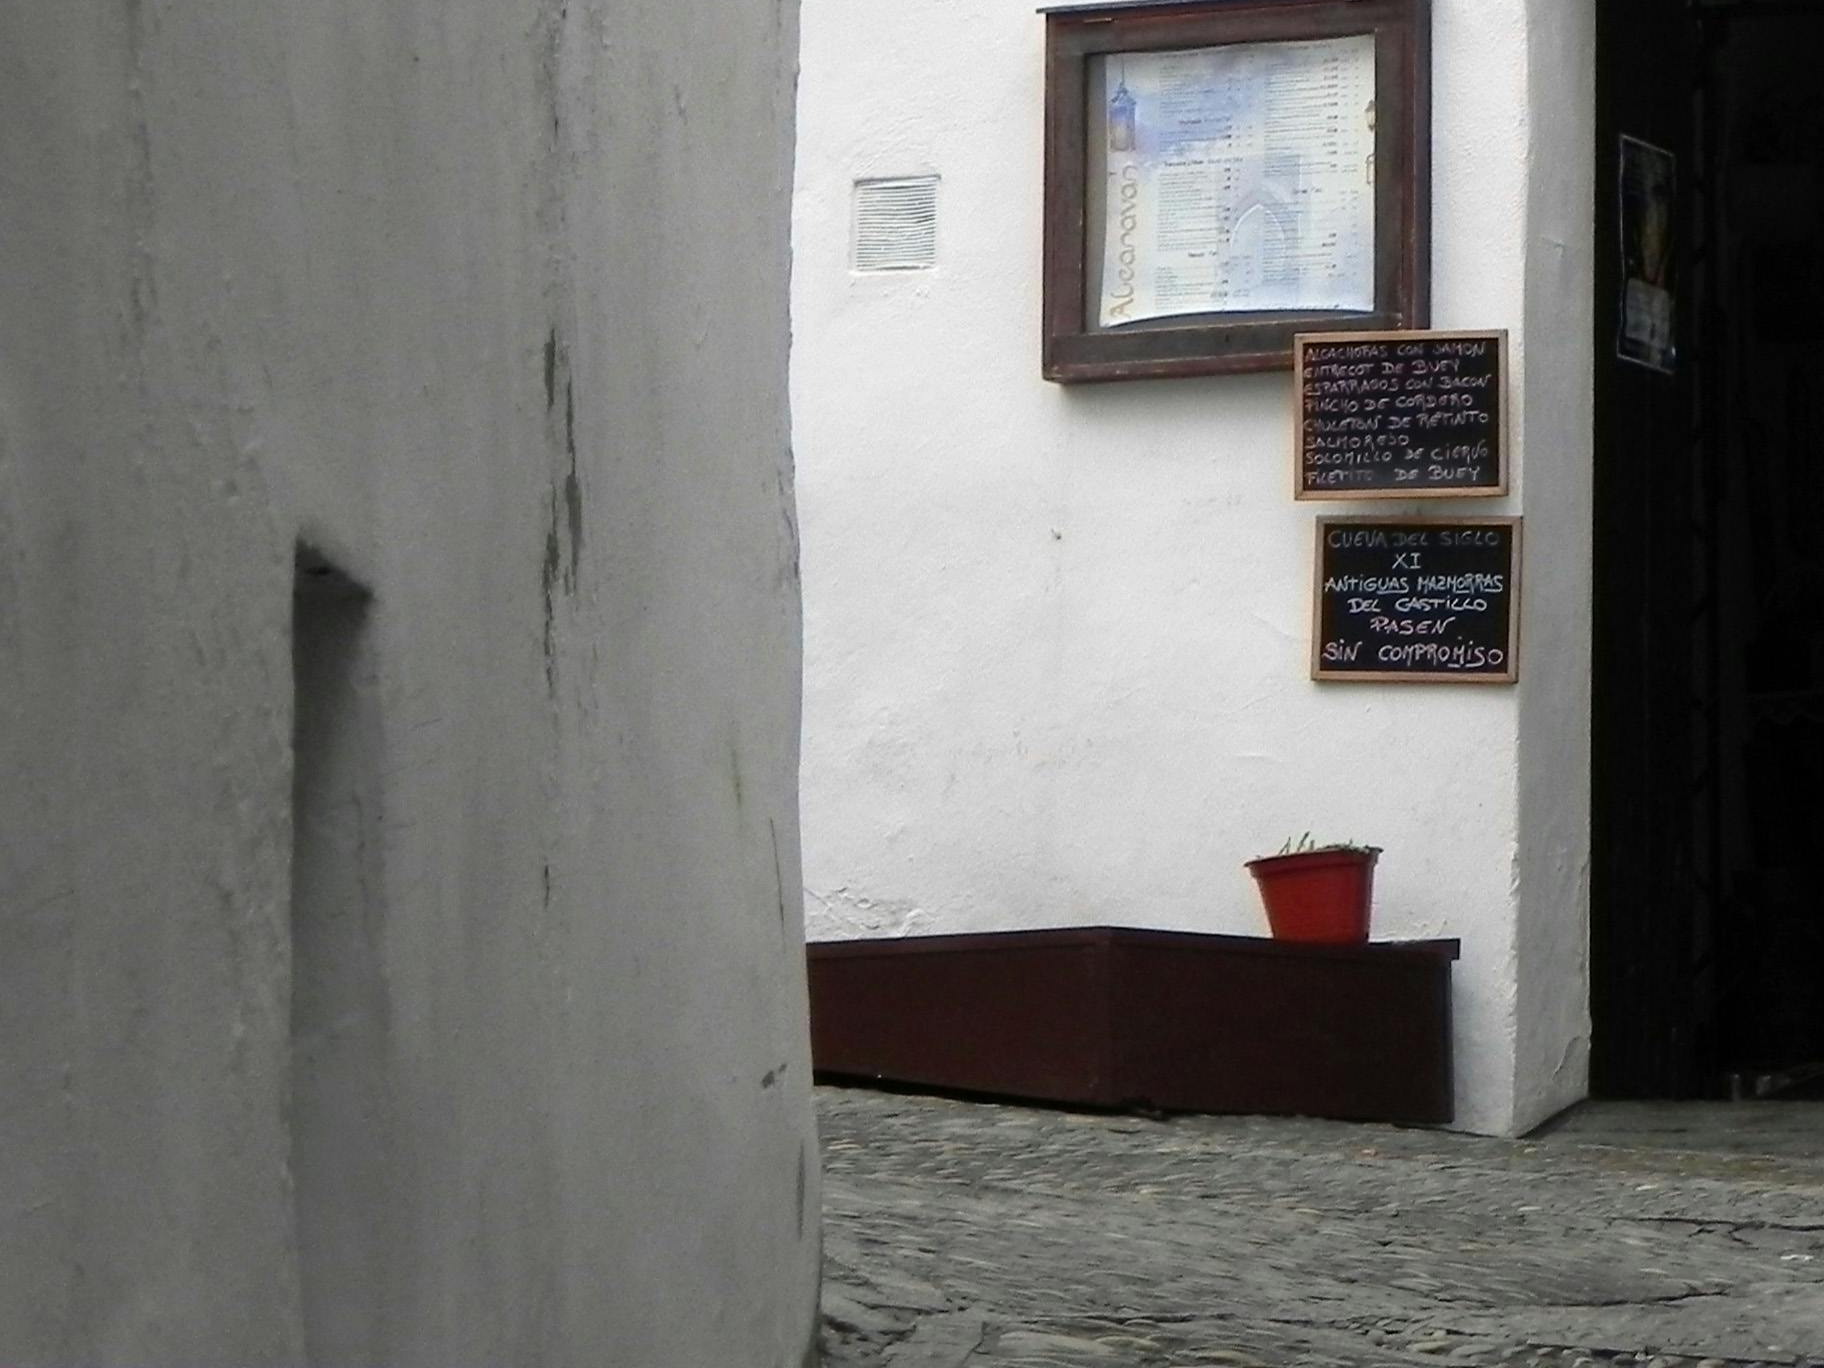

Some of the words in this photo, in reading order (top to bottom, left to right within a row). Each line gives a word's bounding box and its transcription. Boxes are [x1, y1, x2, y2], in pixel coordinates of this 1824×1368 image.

[1397, 343, 1424, 356] CON
[1381, 362, 1404, 374] DE
[1411, 358, 1460, 375] BUEY
[1303, 377, 1399, 396] ESPARRAGOS
[1405, 377, 1433, 390] CON
[1438, 374, 1492, 389] BACON
[1364, 398, 1389, 411] DE
[1395, 393, 1473, 411] CORDERO
[1388, 416, 1412, 430] DE
[1305, 451, 1392, 465] SOLOMILLO
[1405, 447, 1424, 460] DE
[1394, 468, 1419, 481] DE
[1428, 465, 1480, 481] BUEY
[1327, 530, 1388, 549] CUEVA
[1393, 531, 1430, 547] DEL
[1439, 530, 1500, 547] SIGLO
[1391, 552, 1422, 570] XI
[1417, 573, 1504, 595] MAZMORRAS
[1347, 597, 1382, 614] DEL
[1369, 616, 1457, 635] PASEN
